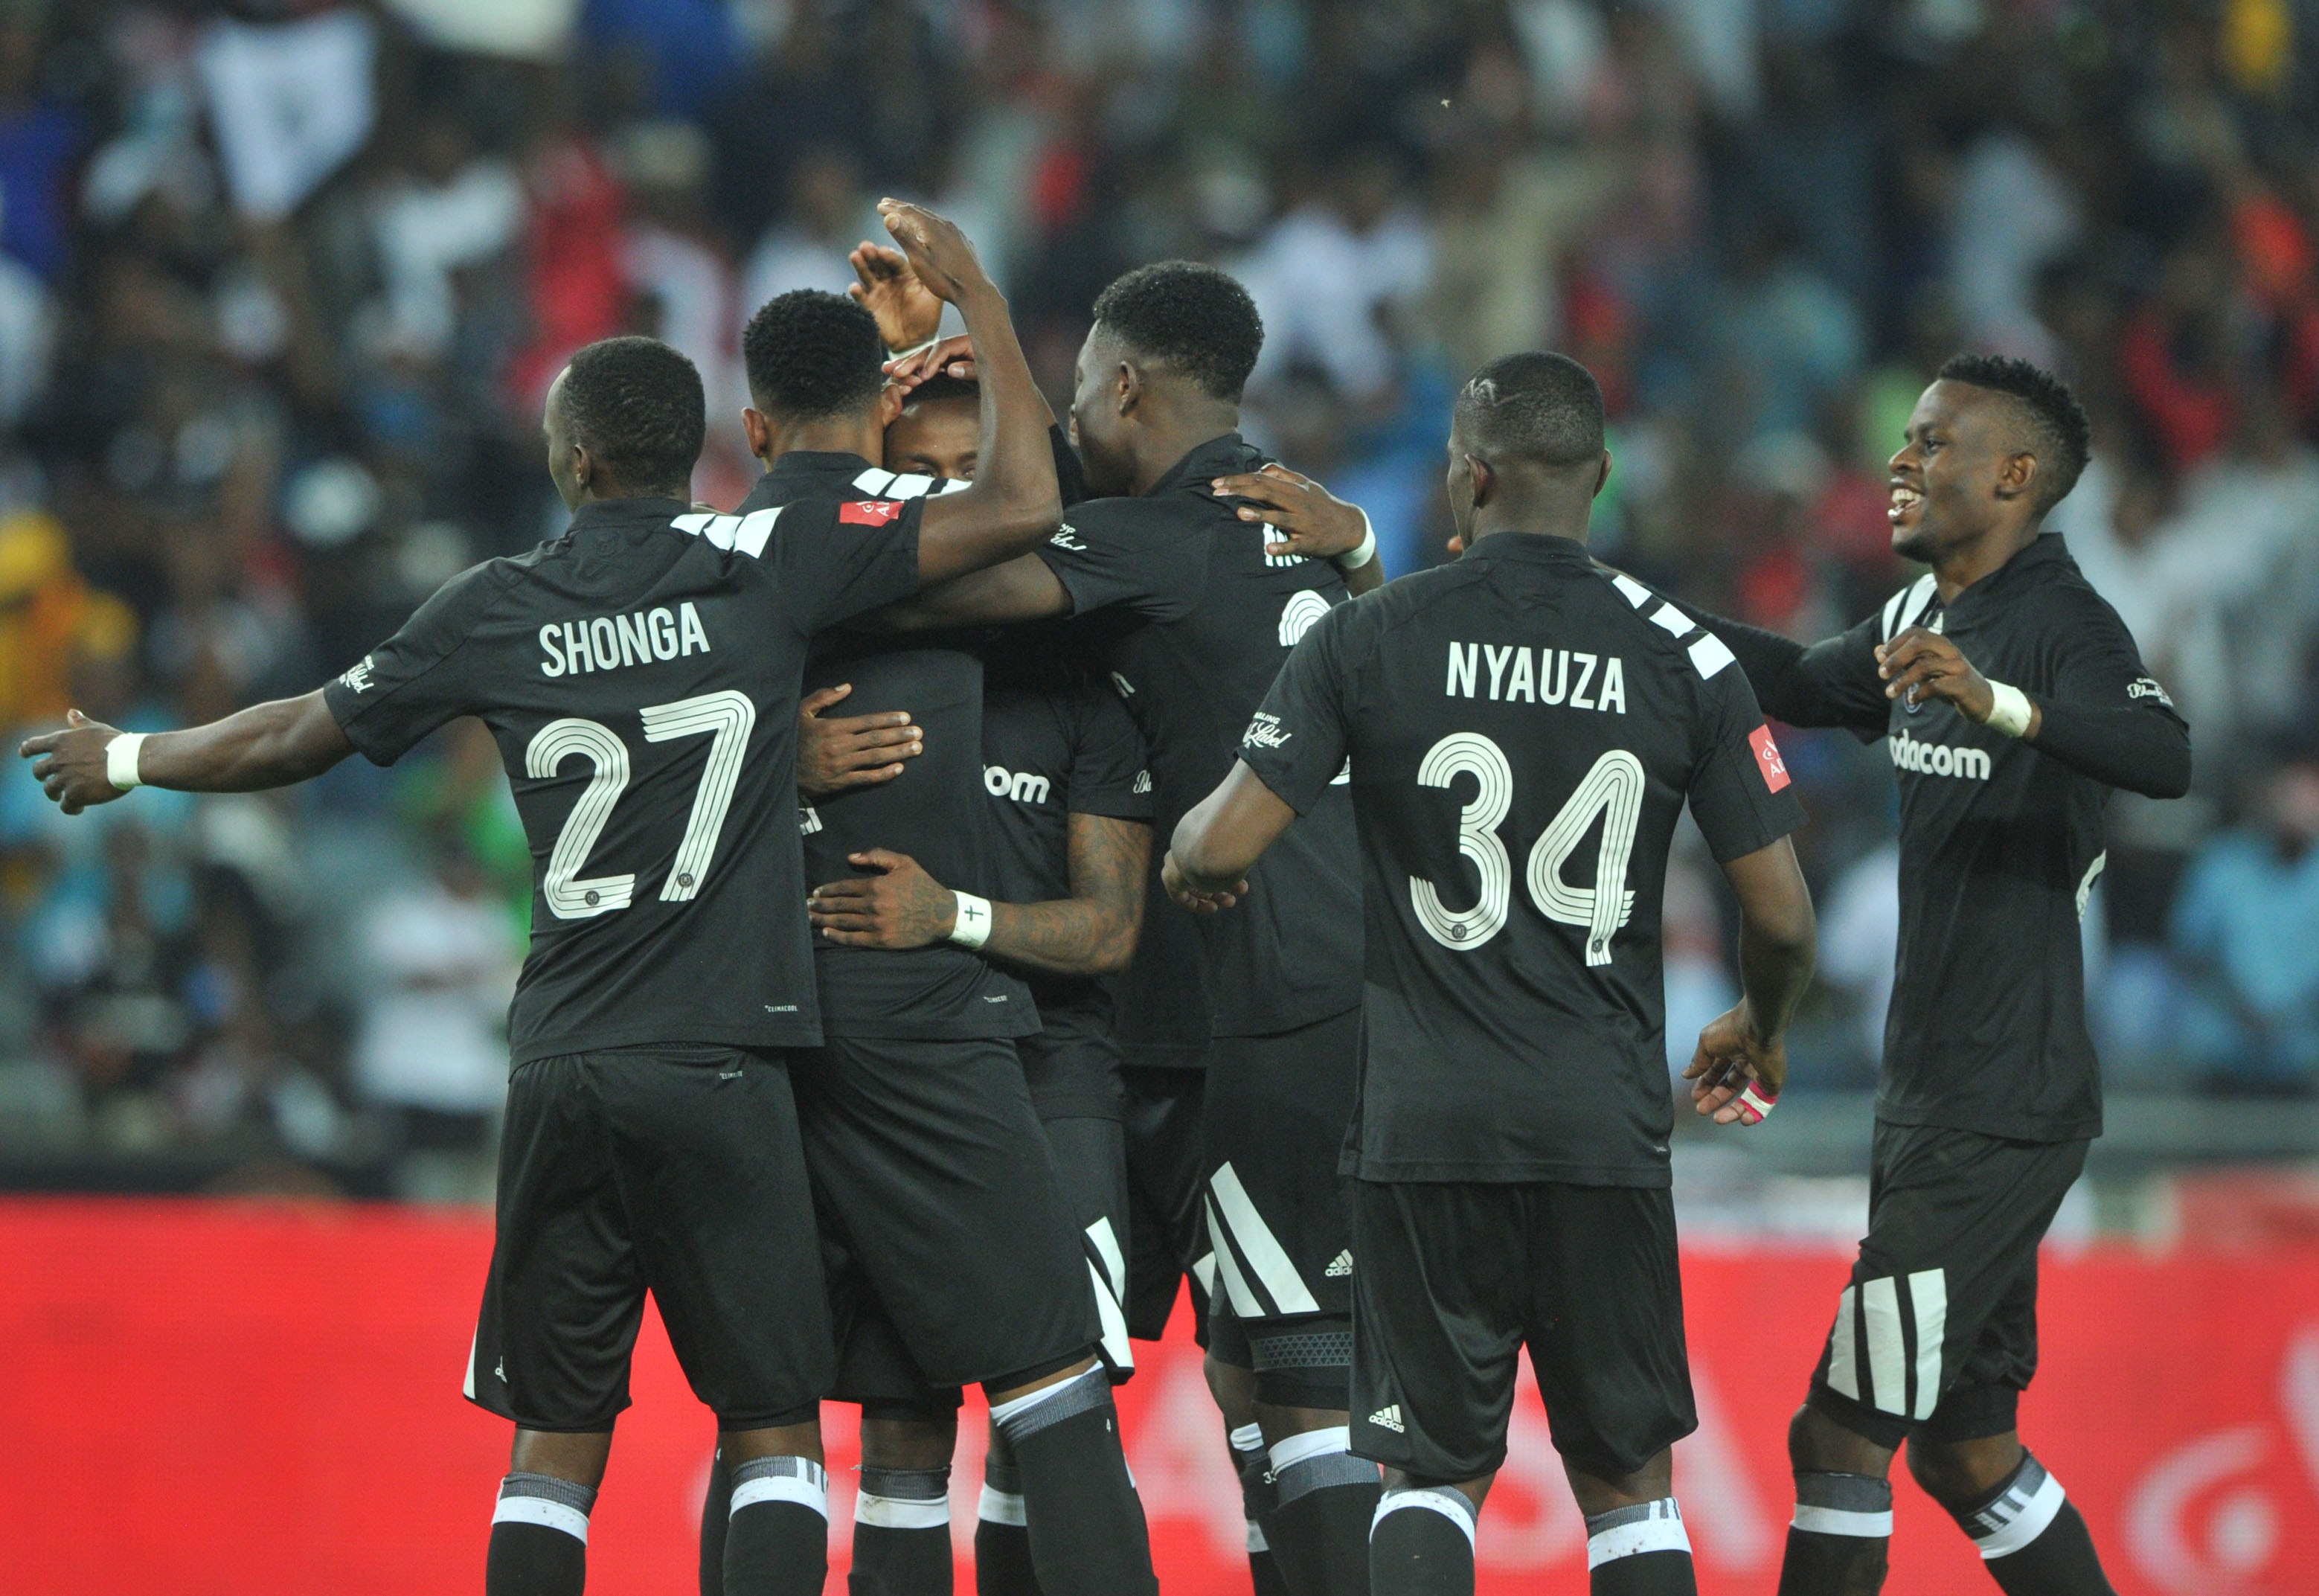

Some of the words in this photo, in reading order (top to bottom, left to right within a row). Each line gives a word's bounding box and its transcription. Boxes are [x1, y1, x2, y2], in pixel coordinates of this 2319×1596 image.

[539, 601, 711, 678] SHONGA
[1446, 641, 1626, 715] NYAUZA
[1889, 728, 1991, 780] odacom
[525, 689, 756, 920] 27
[1409, 731, 1646, 967] 34
[1368, 1414, 1405, 1433] adidas
